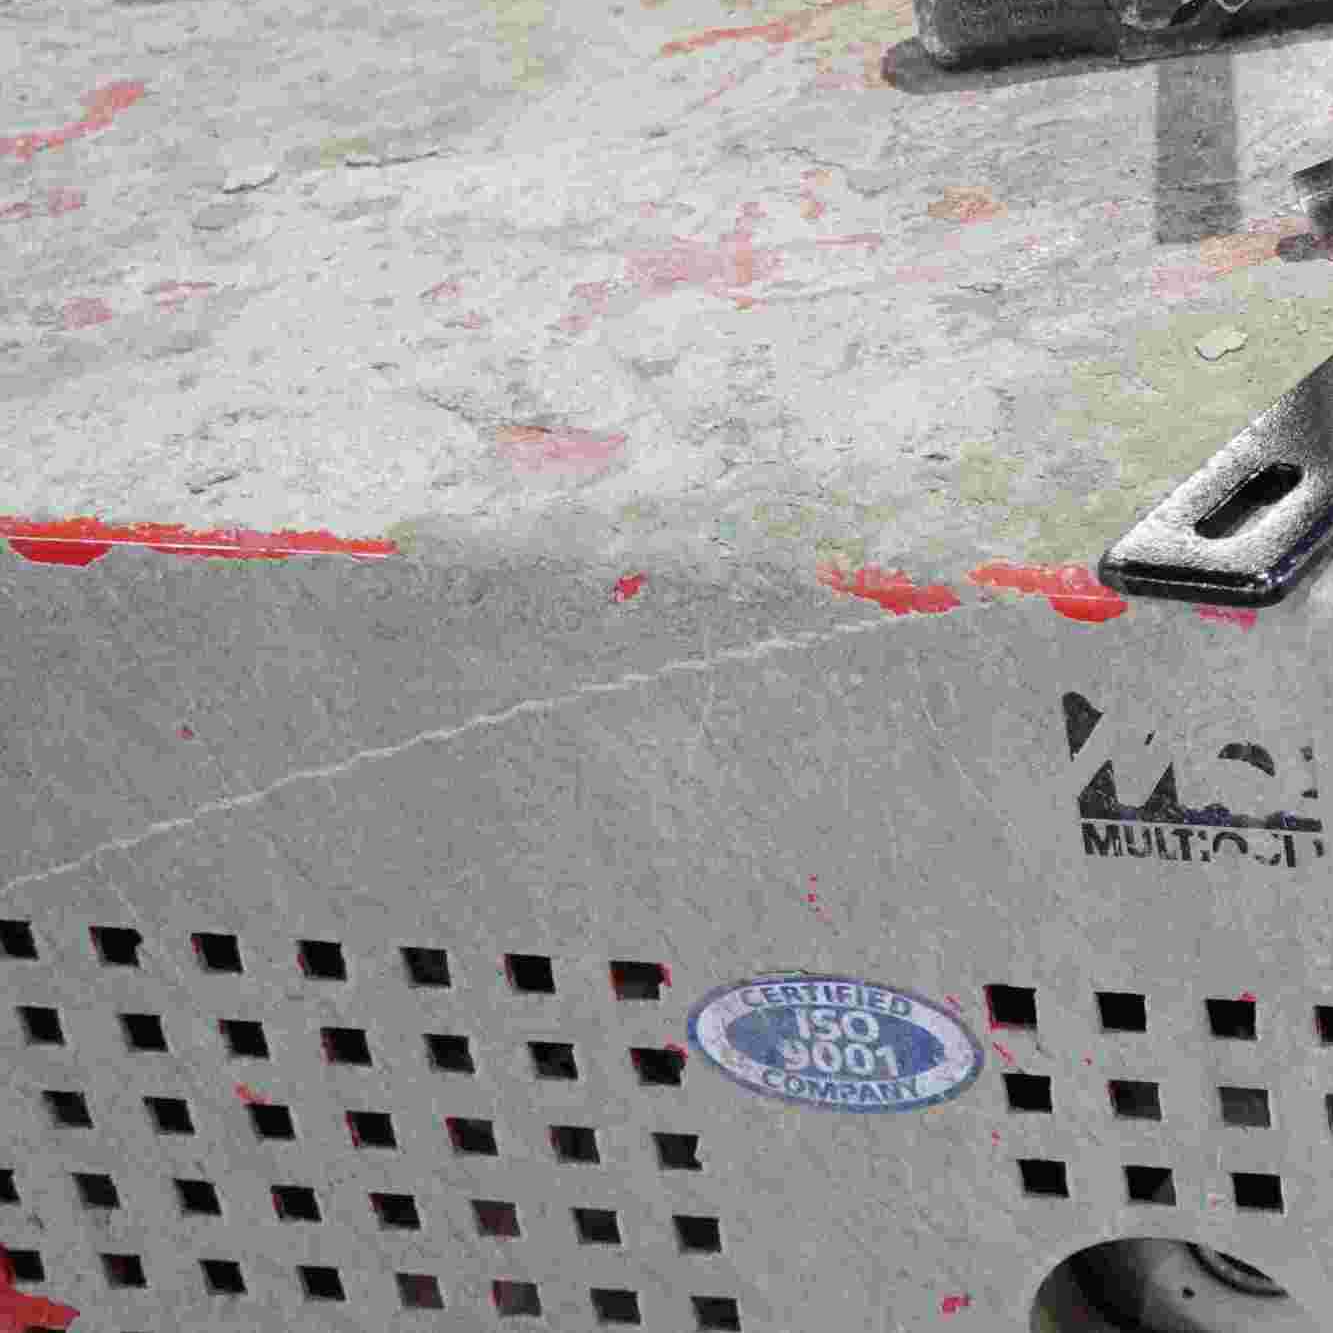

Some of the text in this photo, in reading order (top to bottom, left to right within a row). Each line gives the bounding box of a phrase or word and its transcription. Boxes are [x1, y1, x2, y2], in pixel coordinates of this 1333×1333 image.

[1081, 822, 1324, 868] MULTII
[739, 983, 912, 1017] CERTIFIED
[793, 1008, 881, 1044] ISO
[762, 1067, 919, 1102] COMPANY
